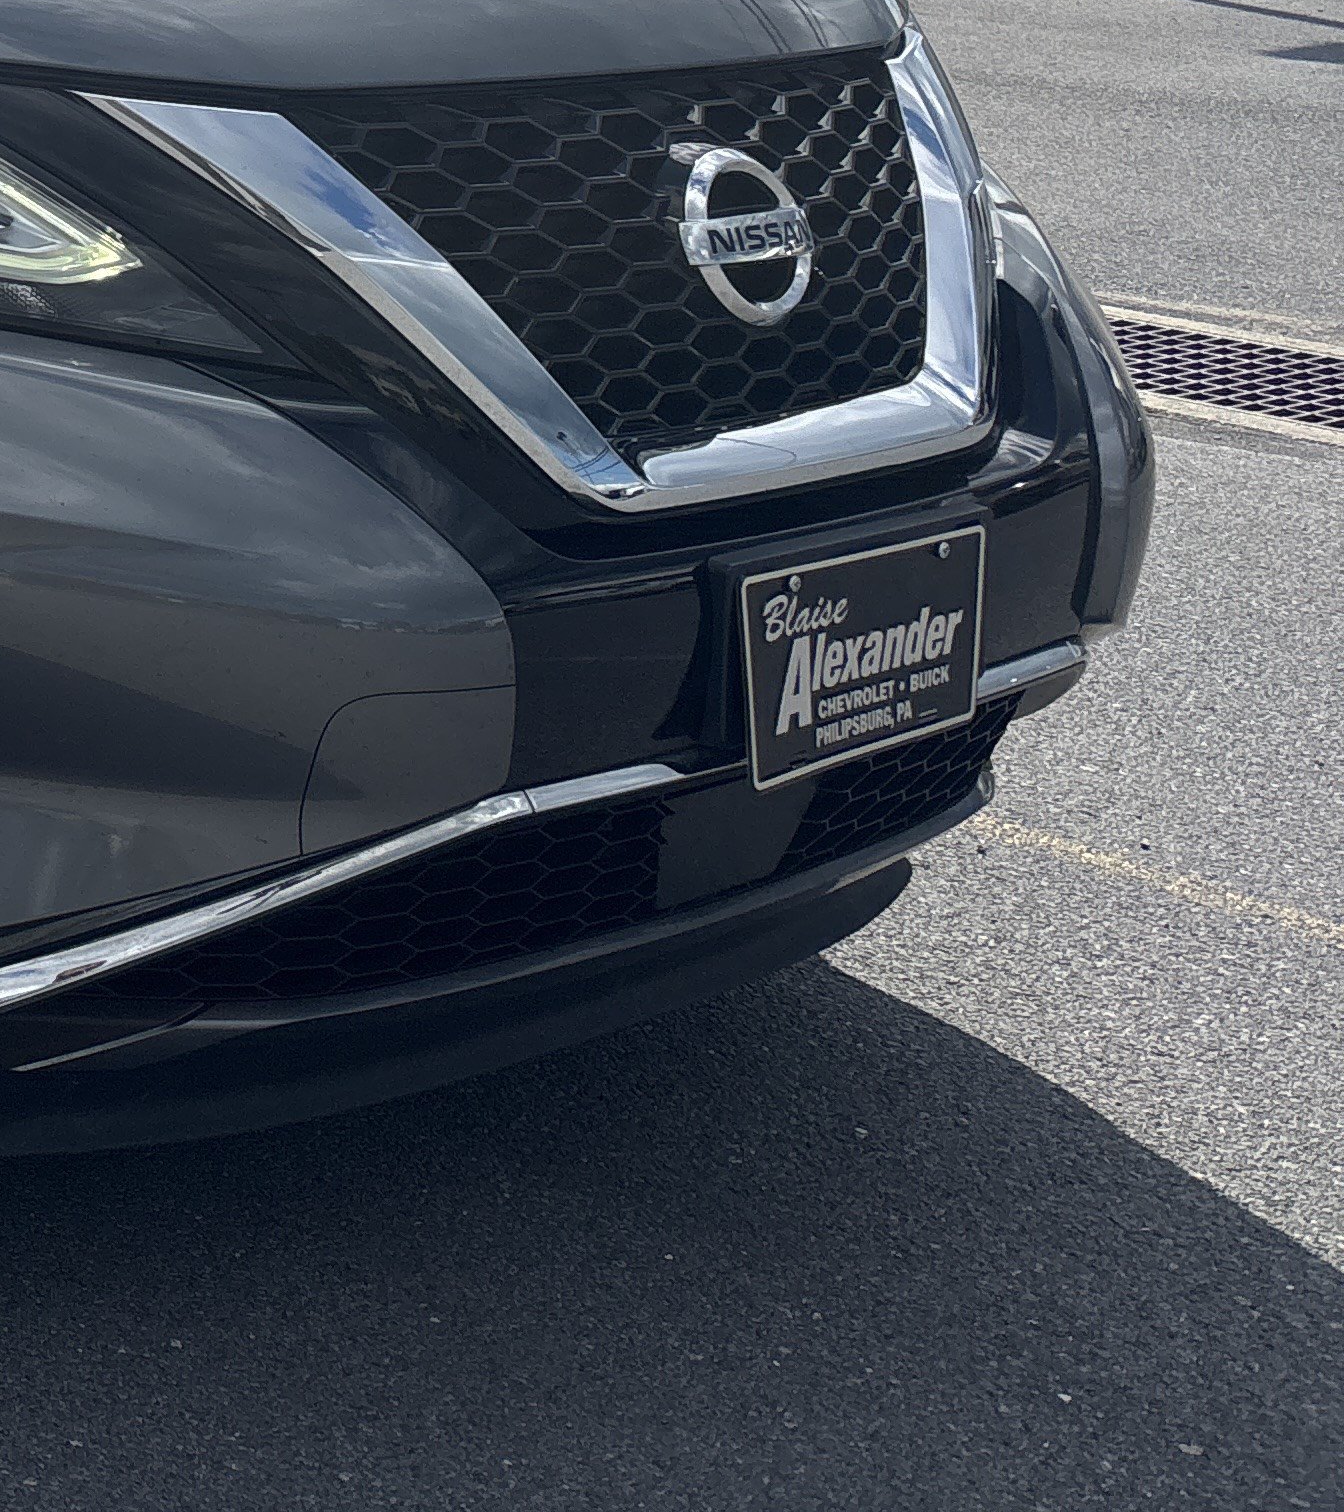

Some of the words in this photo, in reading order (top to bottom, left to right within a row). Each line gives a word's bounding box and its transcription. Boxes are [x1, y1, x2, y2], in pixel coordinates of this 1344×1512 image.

[707, 218, 812, 255] NISSAN
[762, 593, 850, 643] Blaise
[775, 605, 964, 736] Alexander
[817, 679, 896, 720] CHEVROLET
[909, 664, 950, 693] BUICK
[815, 706, 895, 749] PHILIPSBURG,
[896, 699, 913, 722] PA
